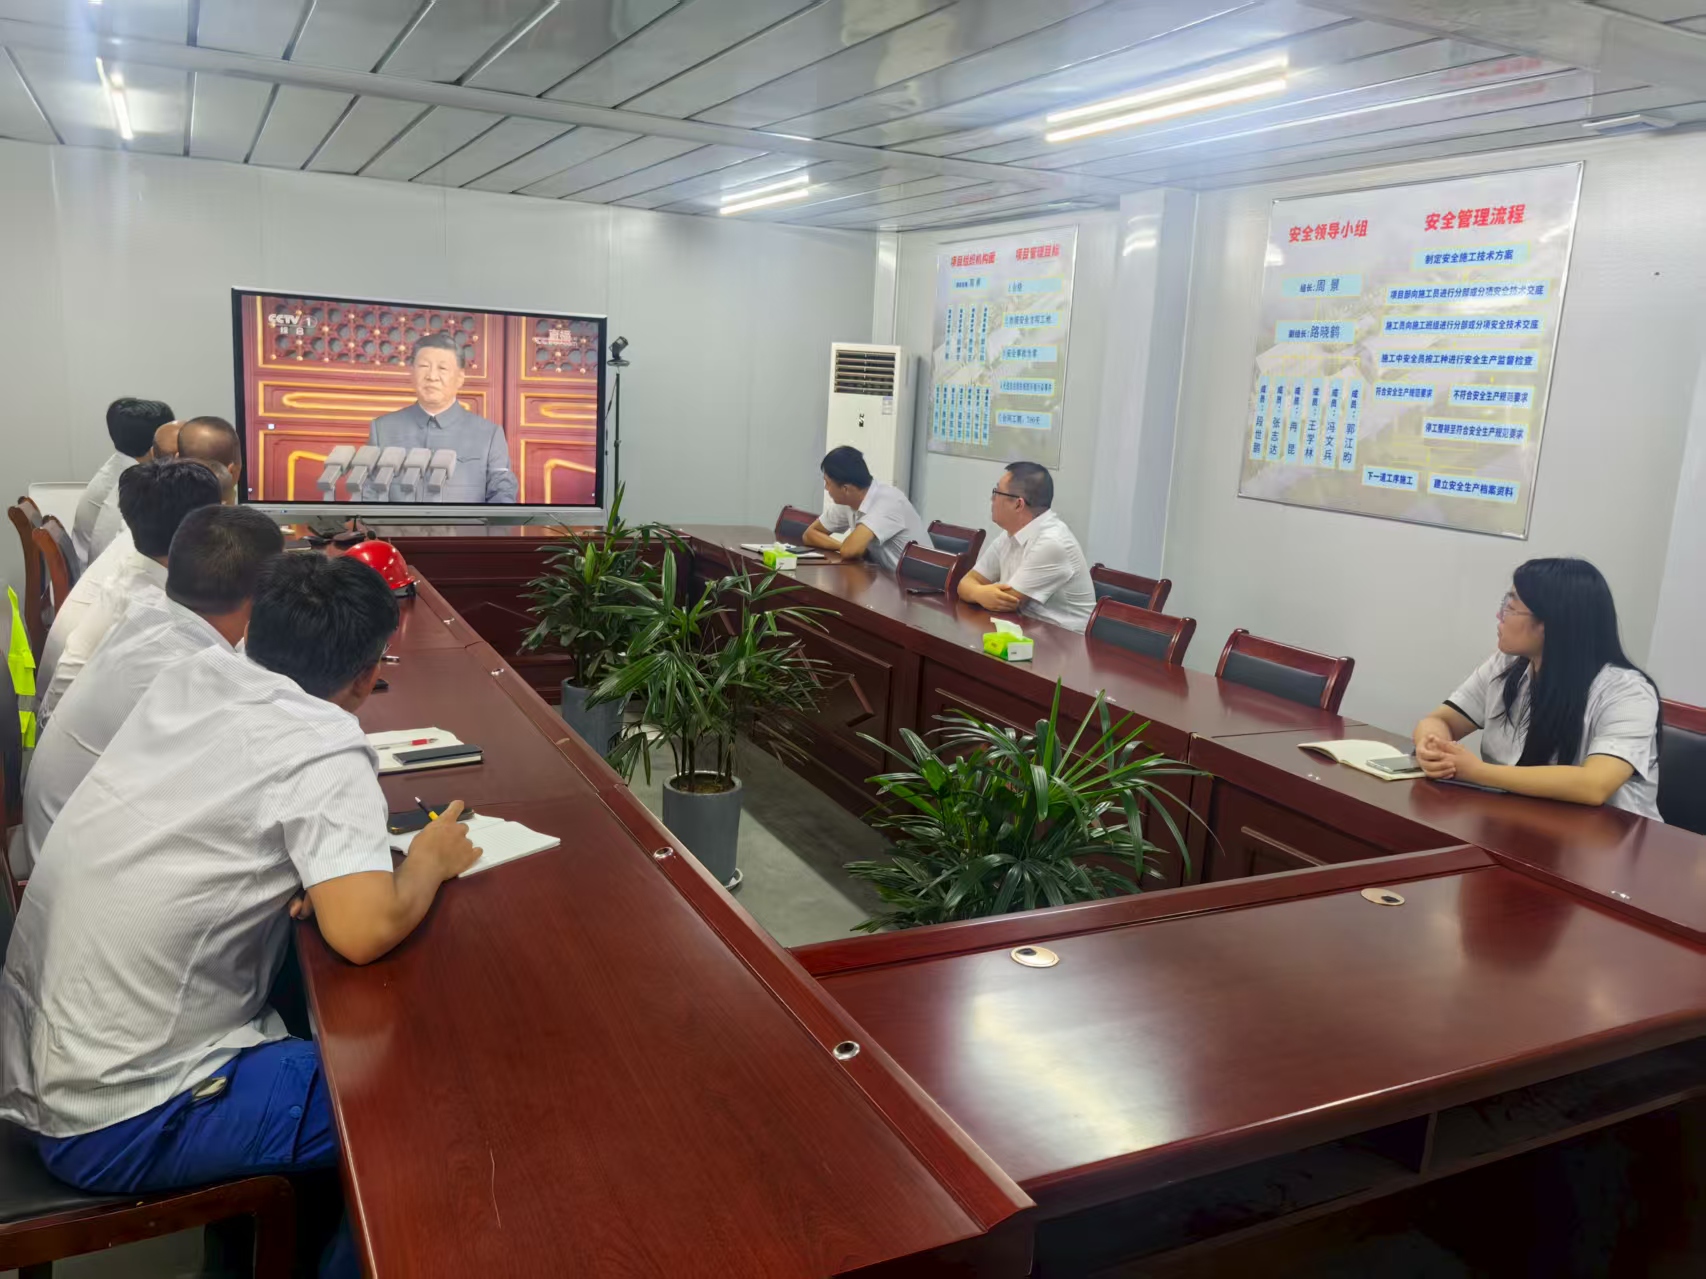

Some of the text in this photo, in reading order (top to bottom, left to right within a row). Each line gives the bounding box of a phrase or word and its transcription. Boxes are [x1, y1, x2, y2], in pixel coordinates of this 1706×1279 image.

[1424, 203, 1526, 232] 安全管理流程
[1288, 220, 1369, 243] 安全领导小组
[1424, 249, 1514, 266] 制定安全施工技术方案
[268, 313, 301, 325] CCTV
[1375, 386, 1433, 399] 符合安全生产规范要求
[1453, 389, 1529, 404] 不符合安全生产规范要求
[1367, 471, 1414, 486] 下一道工序施工
[1433, 478, 1515, 498] 建立安全生产档案资料
